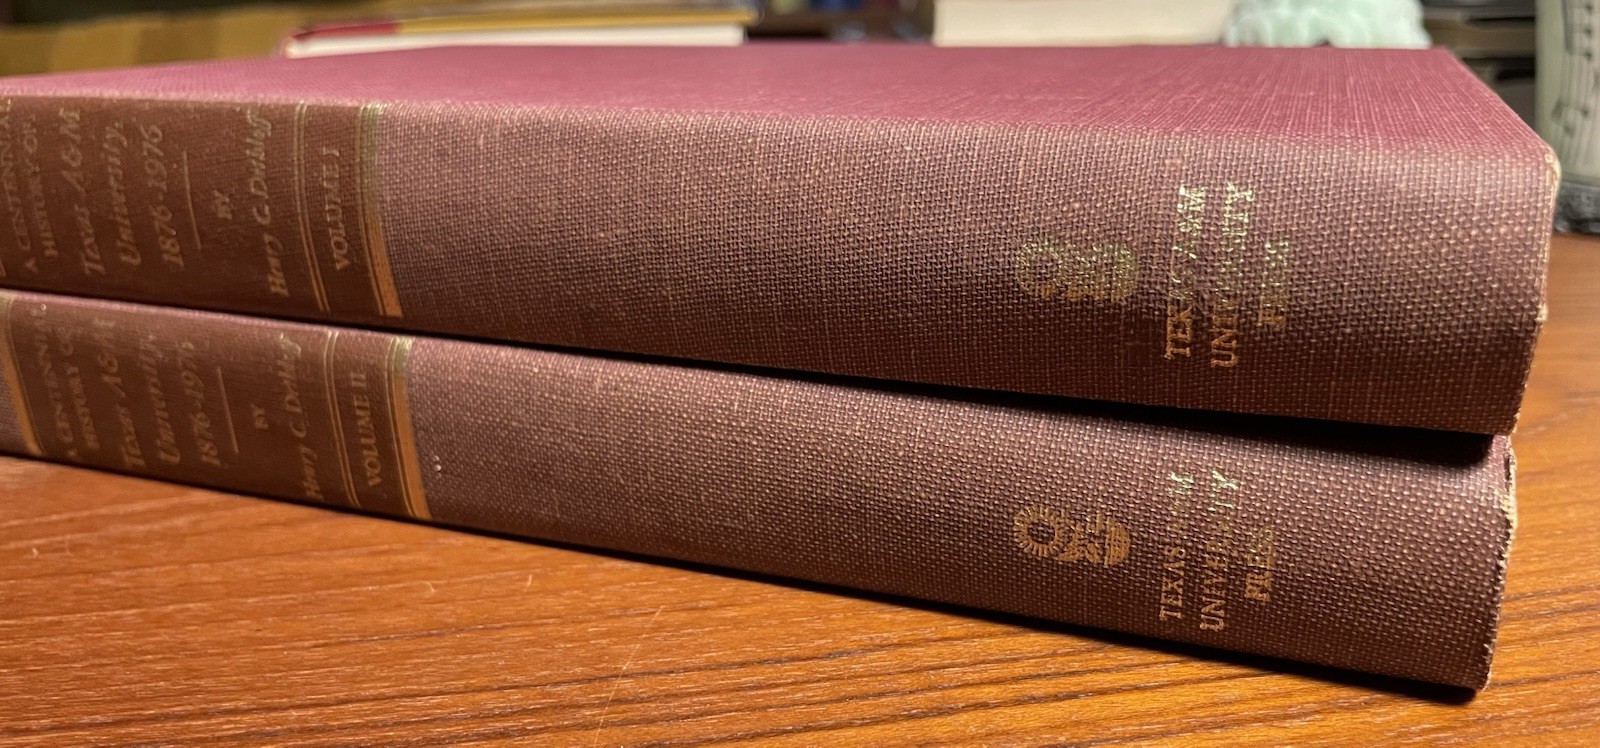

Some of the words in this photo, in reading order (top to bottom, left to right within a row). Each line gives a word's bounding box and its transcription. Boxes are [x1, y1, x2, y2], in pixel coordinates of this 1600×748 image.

[323, 147, 340, 158] I
[323, 164, 350, 271] VOLUME
[350, 371, 368, 389] II
[351, 393, 382, 487] VOLUME
[1158, 546, 1186, 621] TEXAS
[1244, 522, 1274, 603] PRESS
